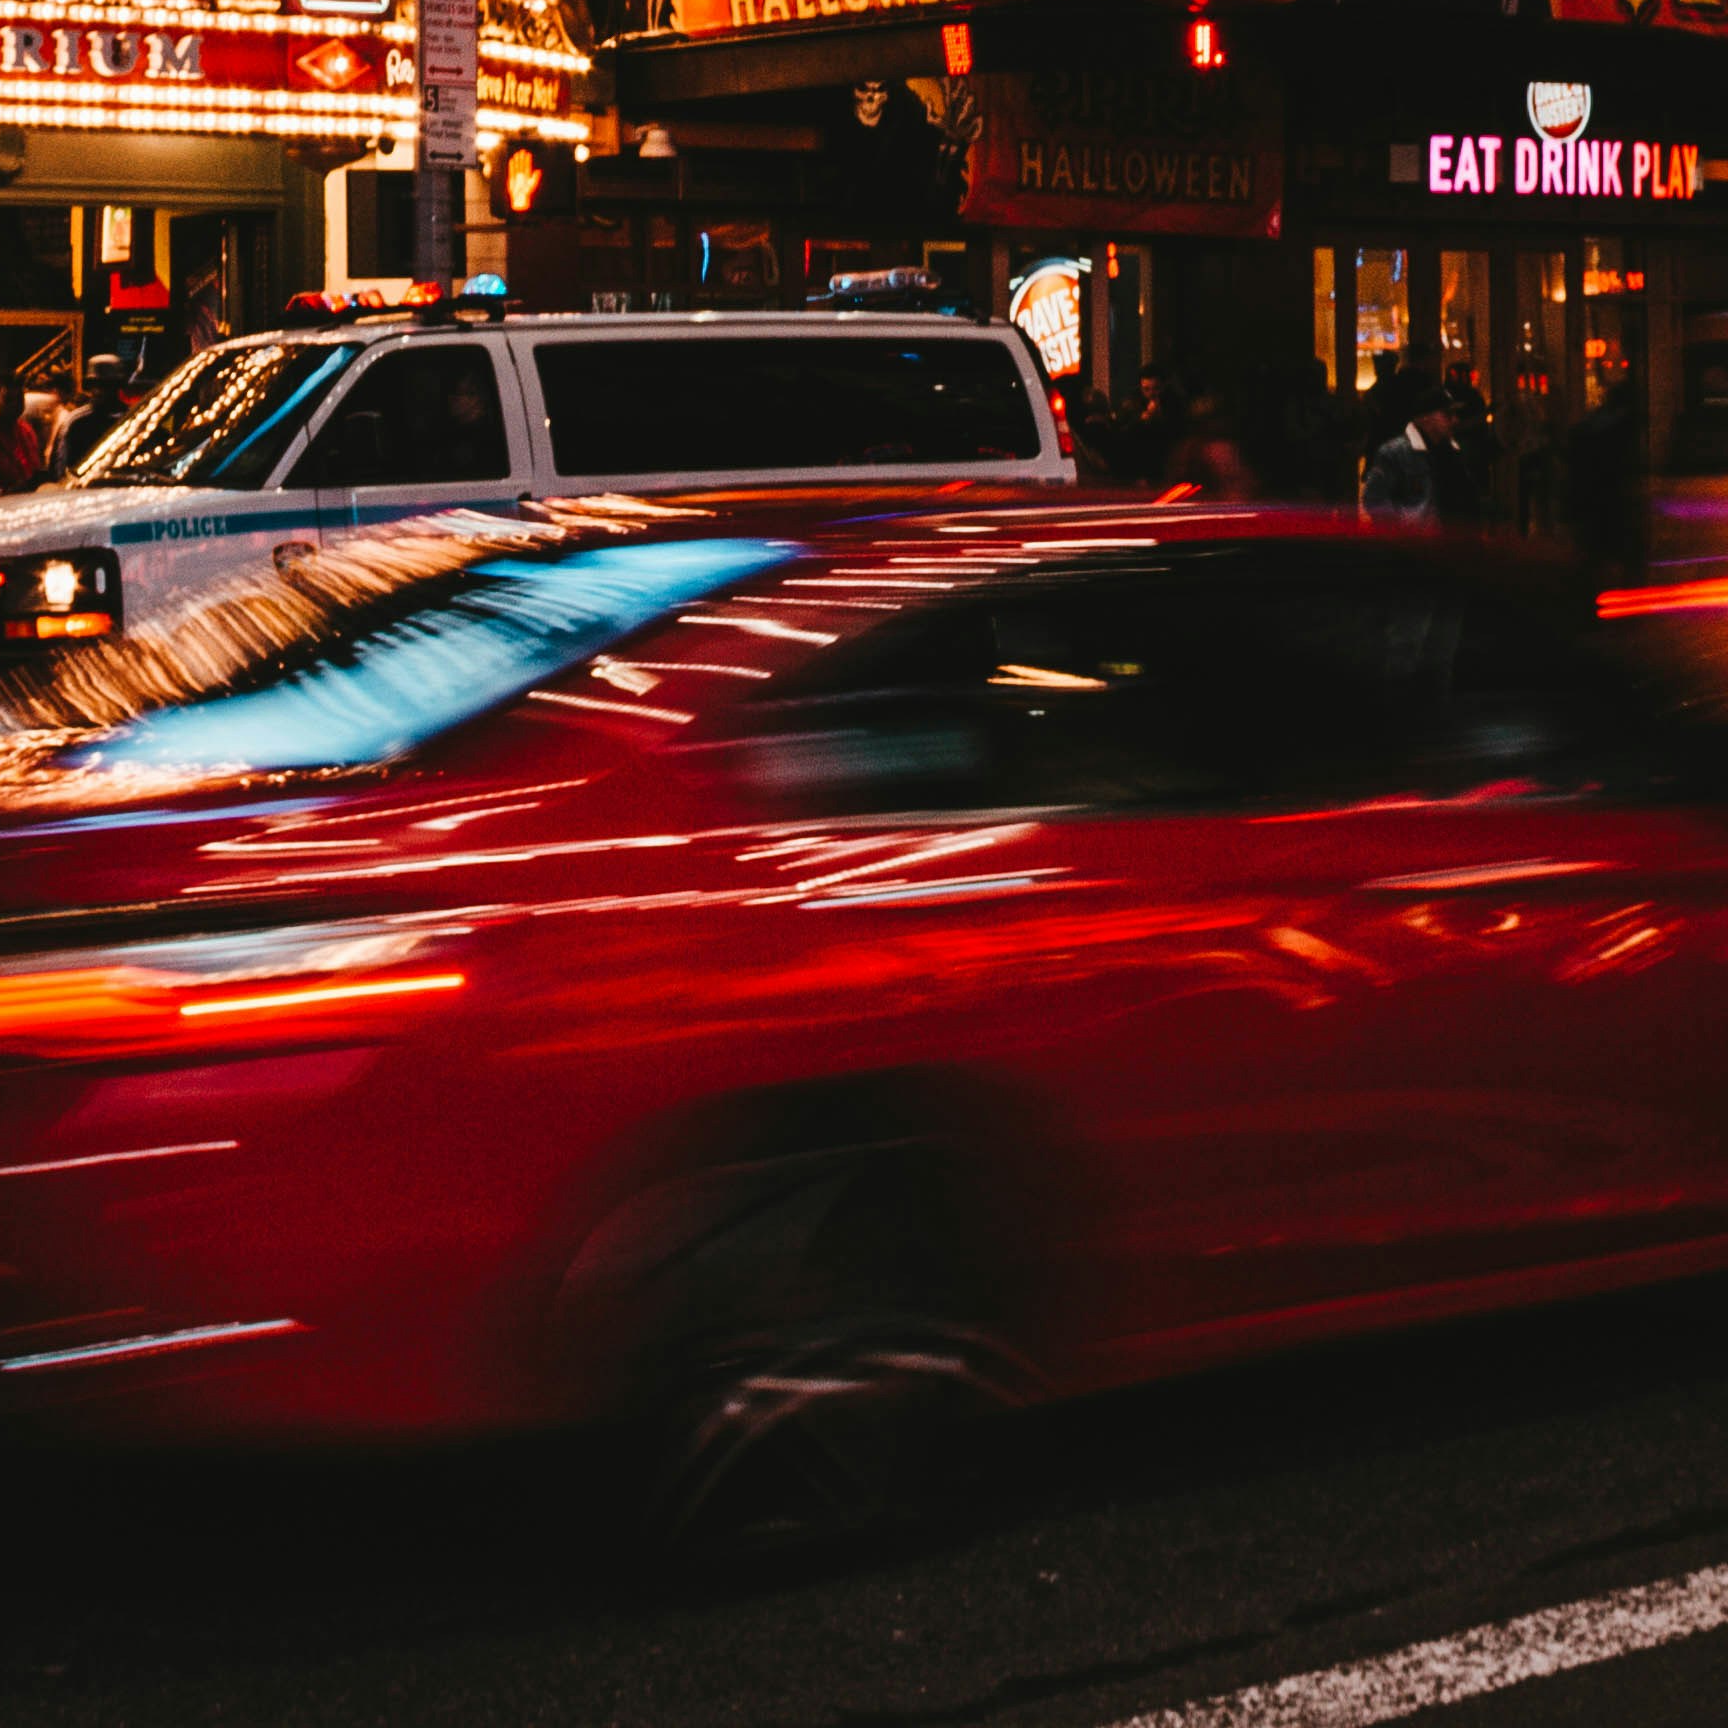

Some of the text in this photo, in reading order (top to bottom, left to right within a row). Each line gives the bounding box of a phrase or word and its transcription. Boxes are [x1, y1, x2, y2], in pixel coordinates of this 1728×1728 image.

[427, 87, 436, 111] 5
[1019, 141, 1250, 200] HALLOWEEN
[1428, 133, 1700, 199] EAT DRINK PLAY
[152, 517, 227, 541] POLICE
